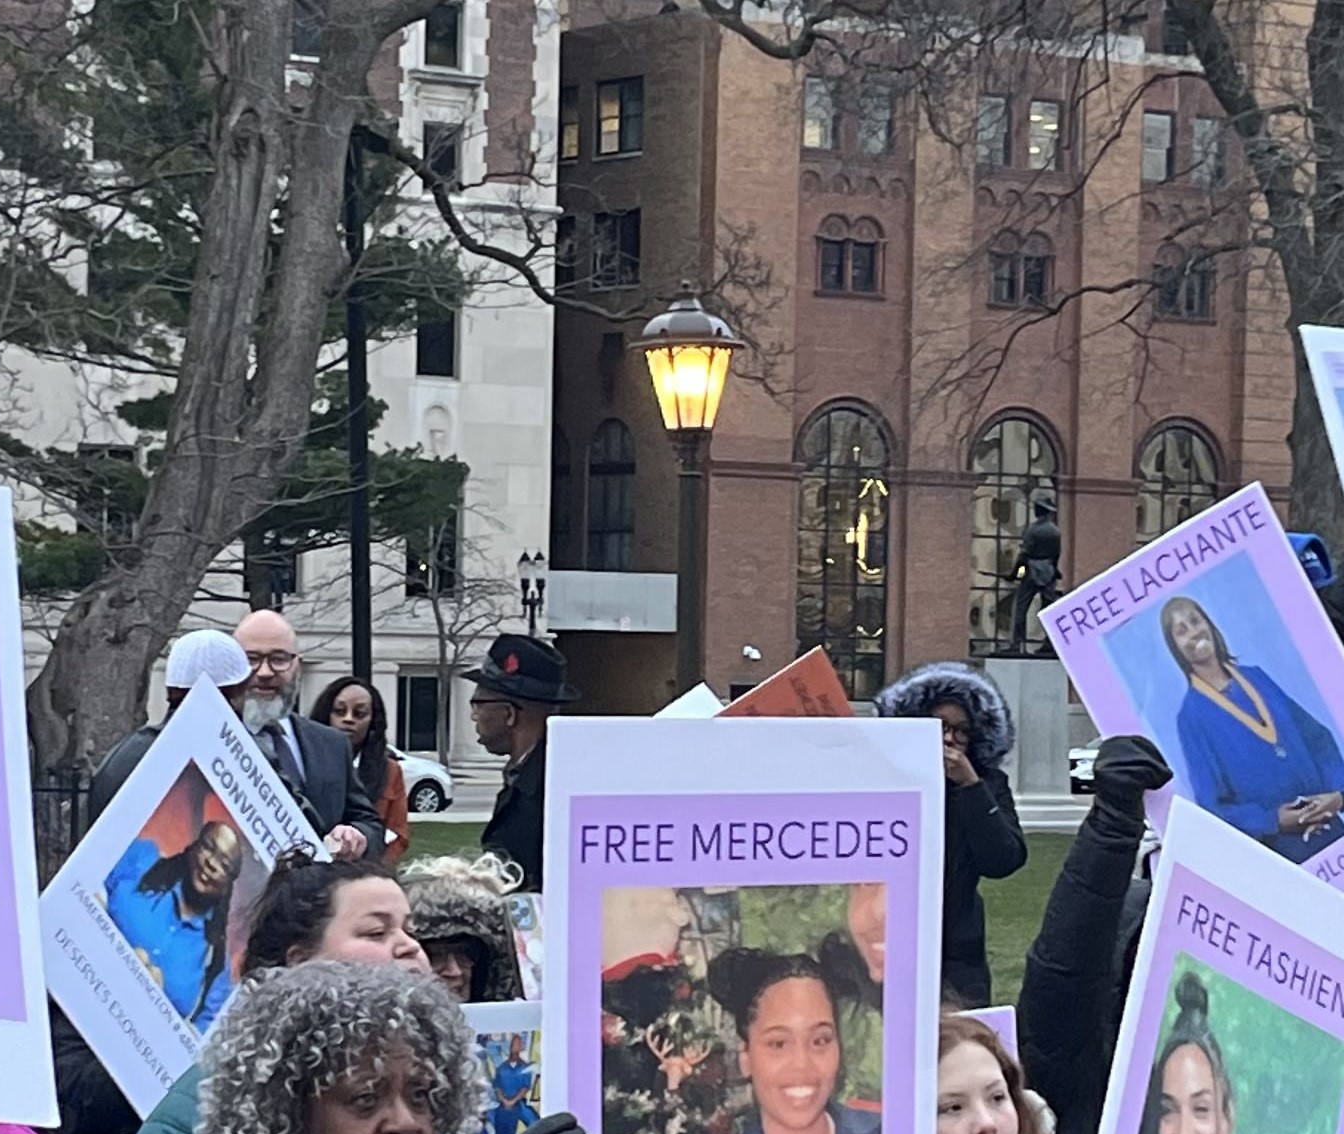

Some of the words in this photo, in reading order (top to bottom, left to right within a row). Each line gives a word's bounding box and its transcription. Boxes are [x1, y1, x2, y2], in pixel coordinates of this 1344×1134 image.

[1056, 586, 1123, 647] FREE
[1128, 500, 1268, 602] LACHANTE
[212, 757, 281, 857] CONVICTE
[580, 822, 675, 864] FREE
[692, 819, 910, 862] MERCEDES
[1176, 893, 1236, 959] FREE
[107, 999, 174, 1090] EXONERATIO
